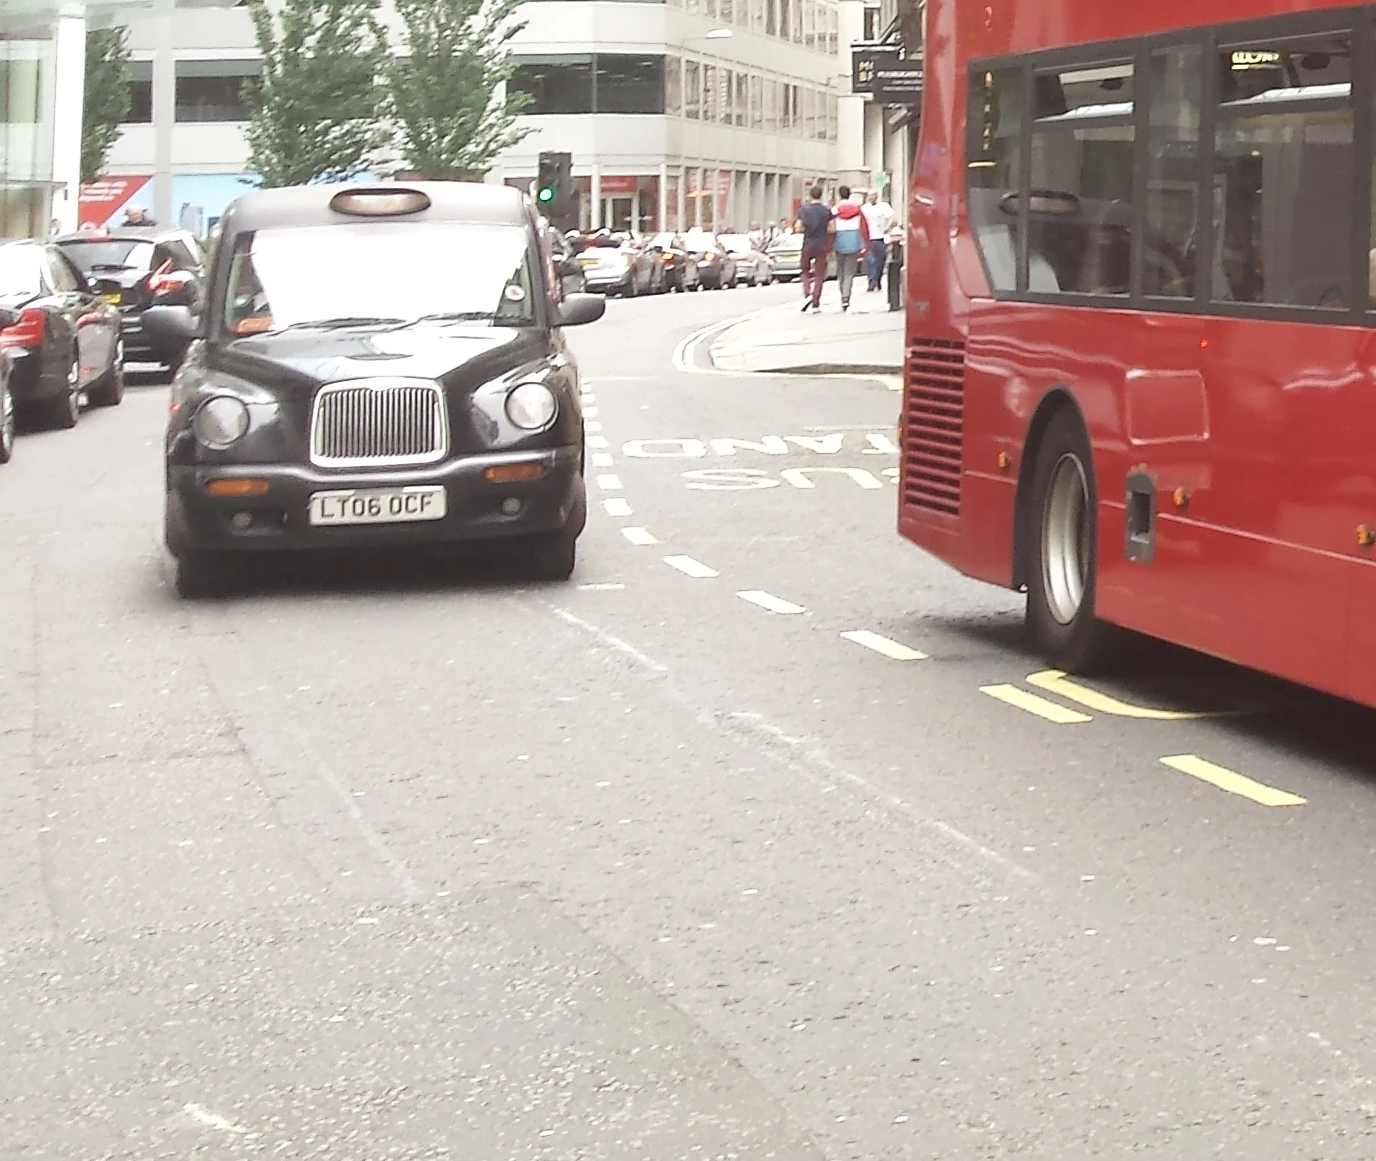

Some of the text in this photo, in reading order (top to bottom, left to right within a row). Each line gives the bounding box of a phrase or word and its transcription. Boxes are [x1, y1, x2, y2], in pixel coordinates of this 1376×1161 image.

[621, 434, 900, 458] TAND
[679, 467, 899, 490] US
[321, 492, 433, 518] LT06 OCF
